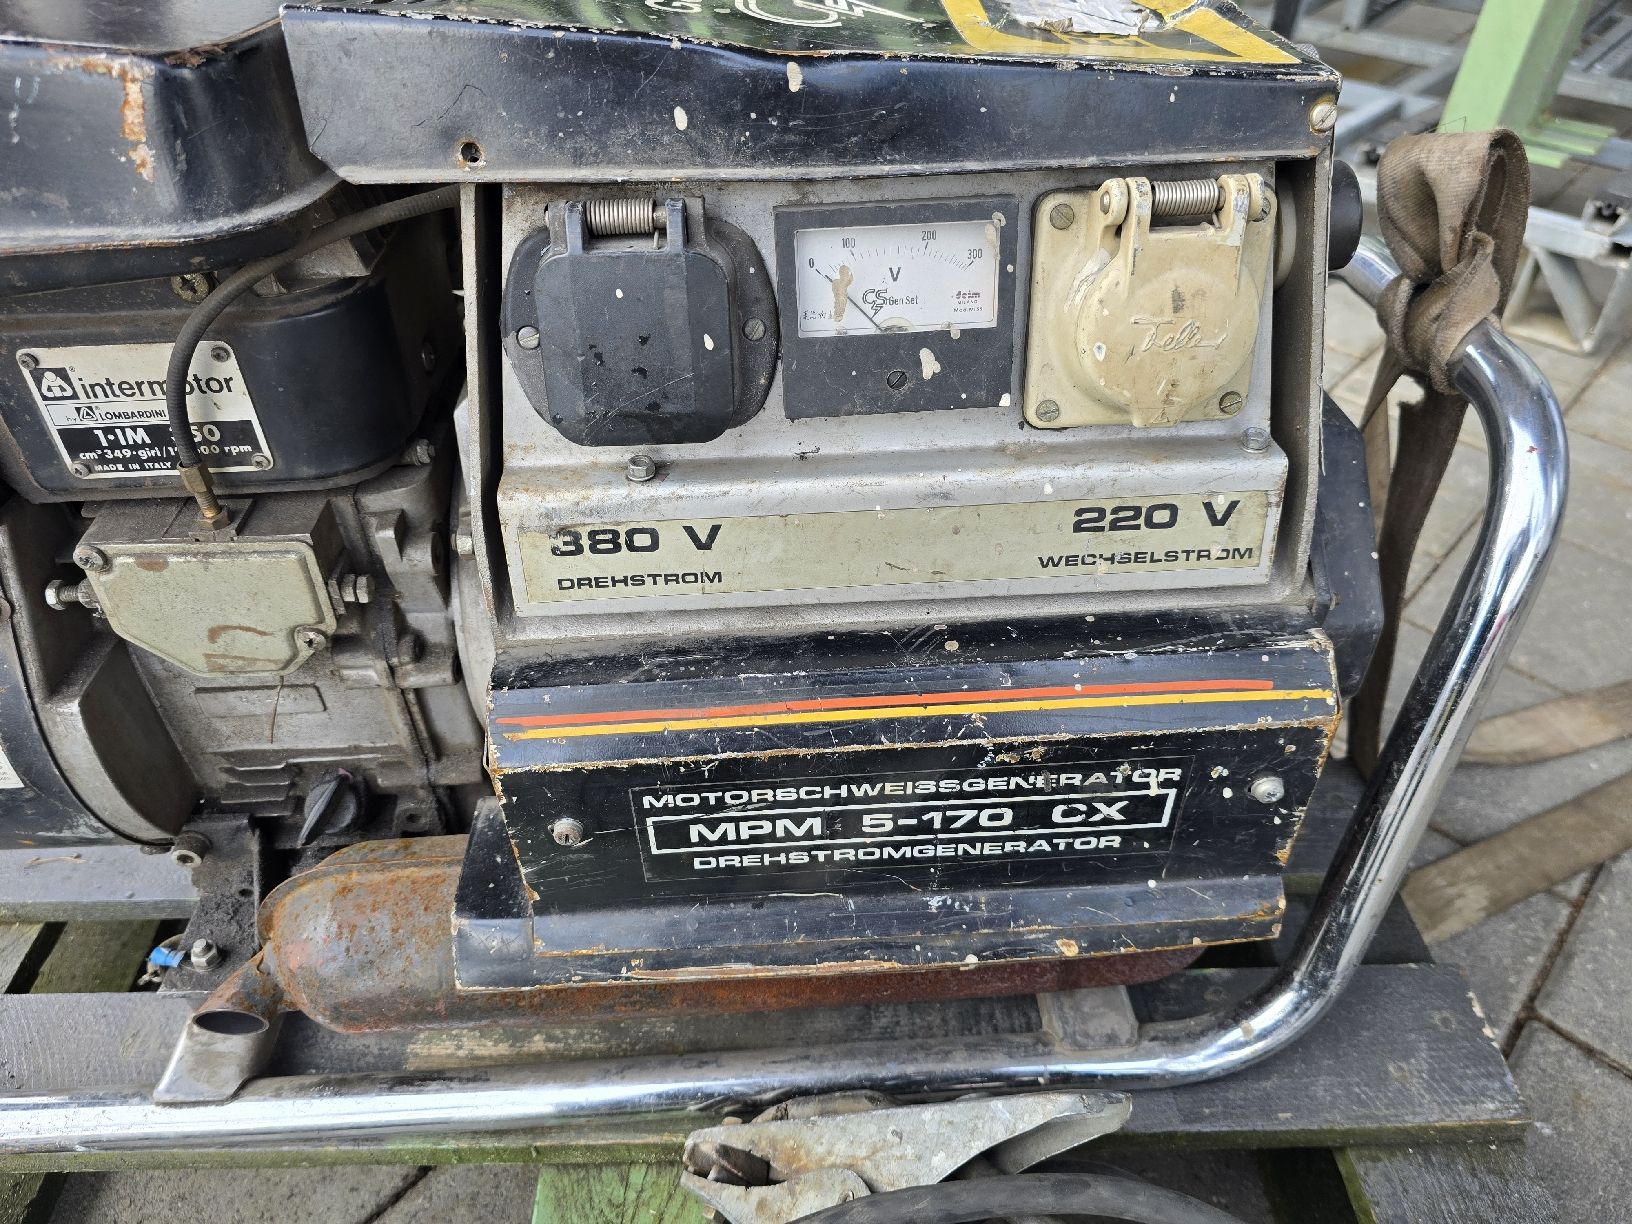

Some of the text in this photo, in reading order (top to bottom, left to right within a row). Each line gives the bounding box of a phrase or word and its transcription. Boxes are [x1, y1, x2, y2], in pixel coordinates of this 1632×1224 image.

[842, 237, 856, 249] 100
[921, 229, 937, 241] 200
[967, 248, 983, 260] 300
[808, 257, 815, 269] 0
[888, 266, 902, 282] V
[905, 295, 919, 305] Set
[99, 410, 167, 421] LOMBARDINI
[169, 424, 221, 443] 50
[223, 445, 253, 456] rpm
[94, 461, 172, 471] MADE IN ITALY
[1072, 499, 1241, 533] 220 V
[550, 524, 722, 557] 380 V
[1037, 547, 1254, 569] WECHSELSTROM
[557, 571, 723, 591] DREHSTROM
[642, 767, 1183, 809] MOTORSCHWEISSGENERATOR
[689, 800, 1130, 844] MPM 5-170 CX
[693, 835, 1122, 870] DREHSTROMGENERATOR
